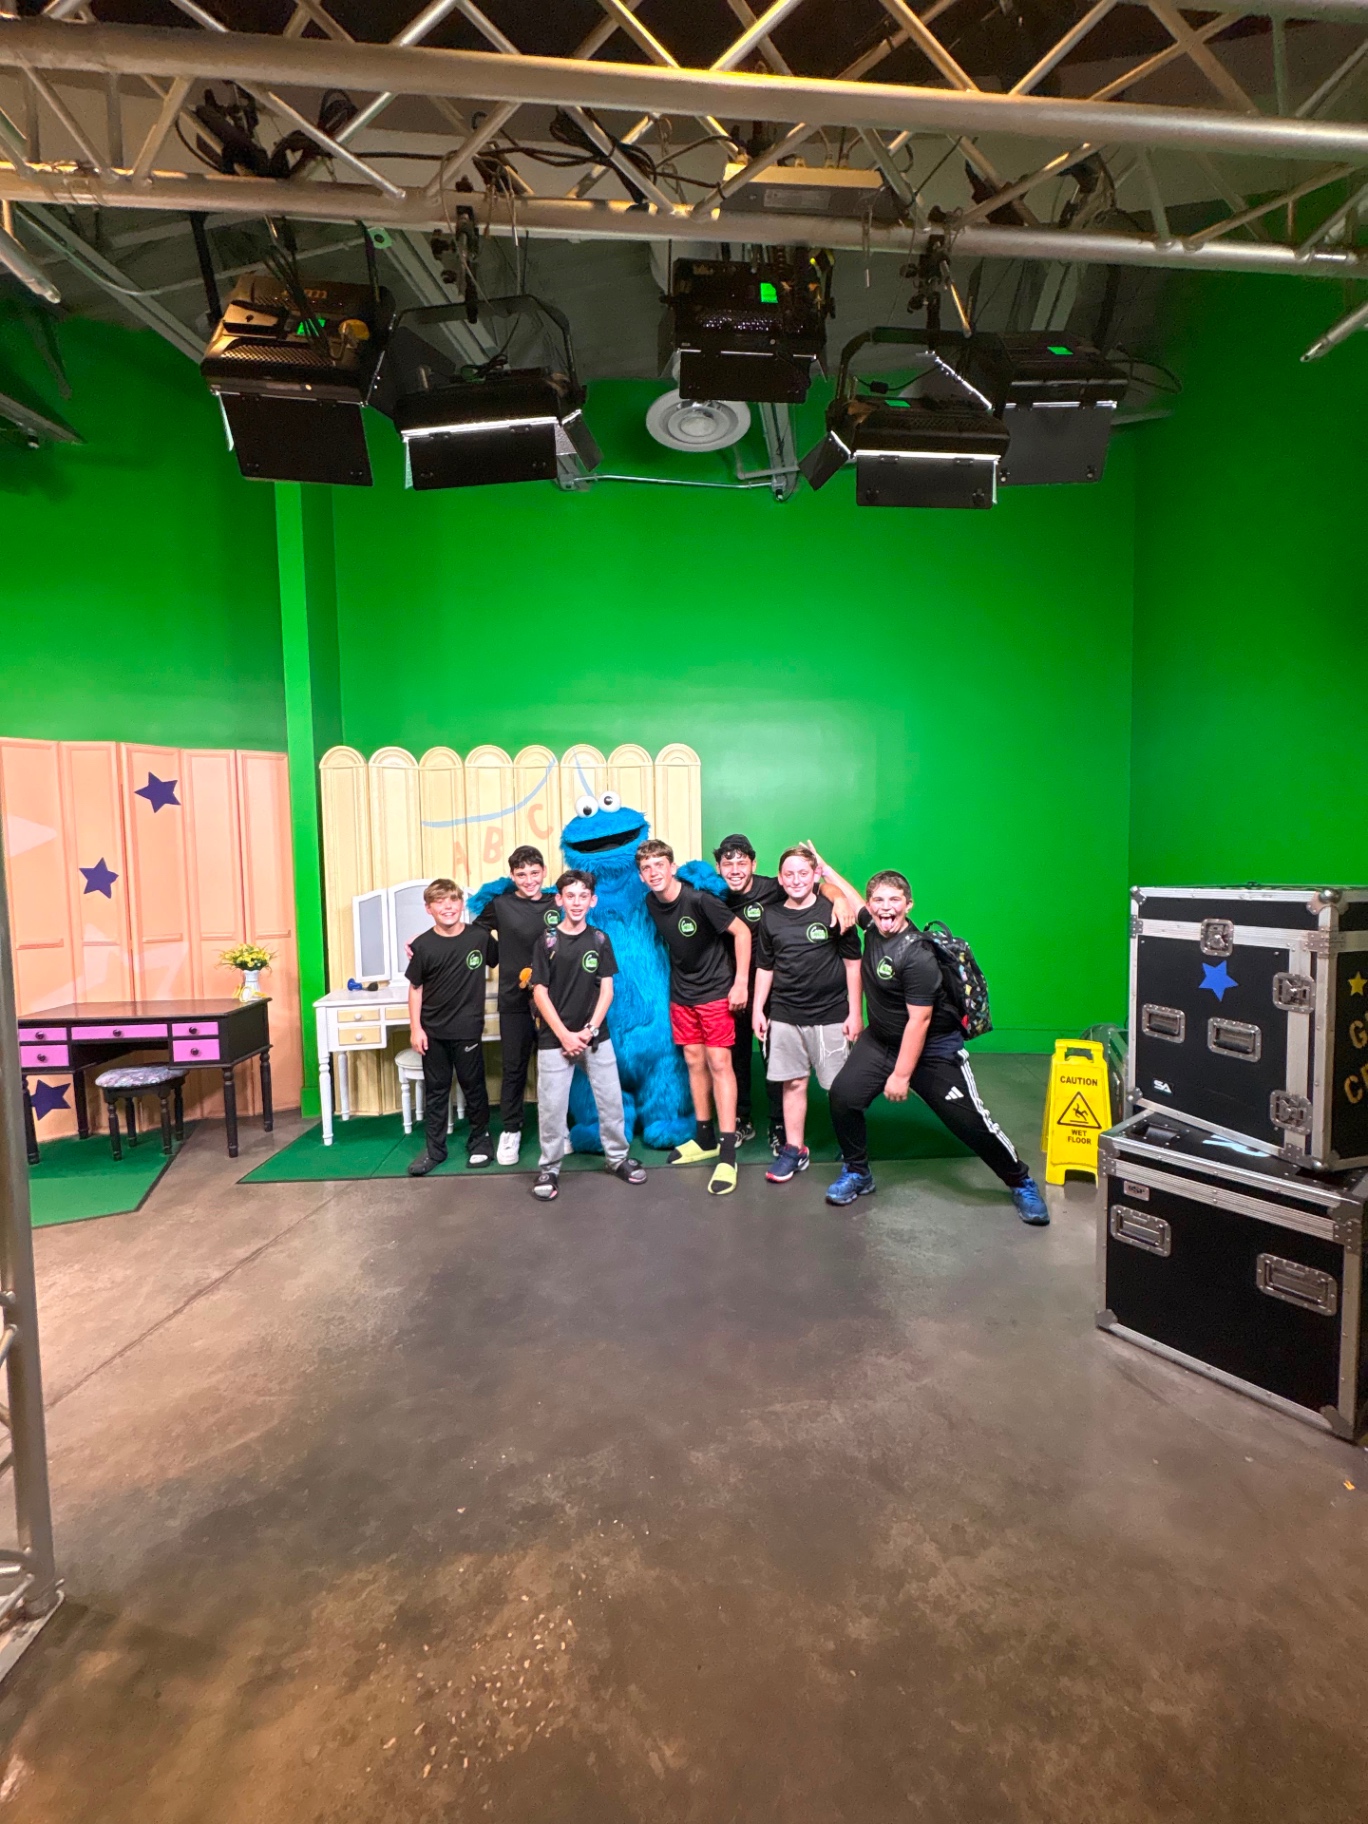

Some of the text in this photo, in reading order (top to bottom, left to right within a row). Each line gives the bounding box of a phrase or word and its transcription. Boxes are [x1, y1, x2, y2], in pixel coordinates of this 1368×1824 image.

[1060, 1075, 1098, 1087] CAUTION
[1071, 1129, 1087, 1137] WET
[1067, 1136, 1092, 1145] FLOOR
